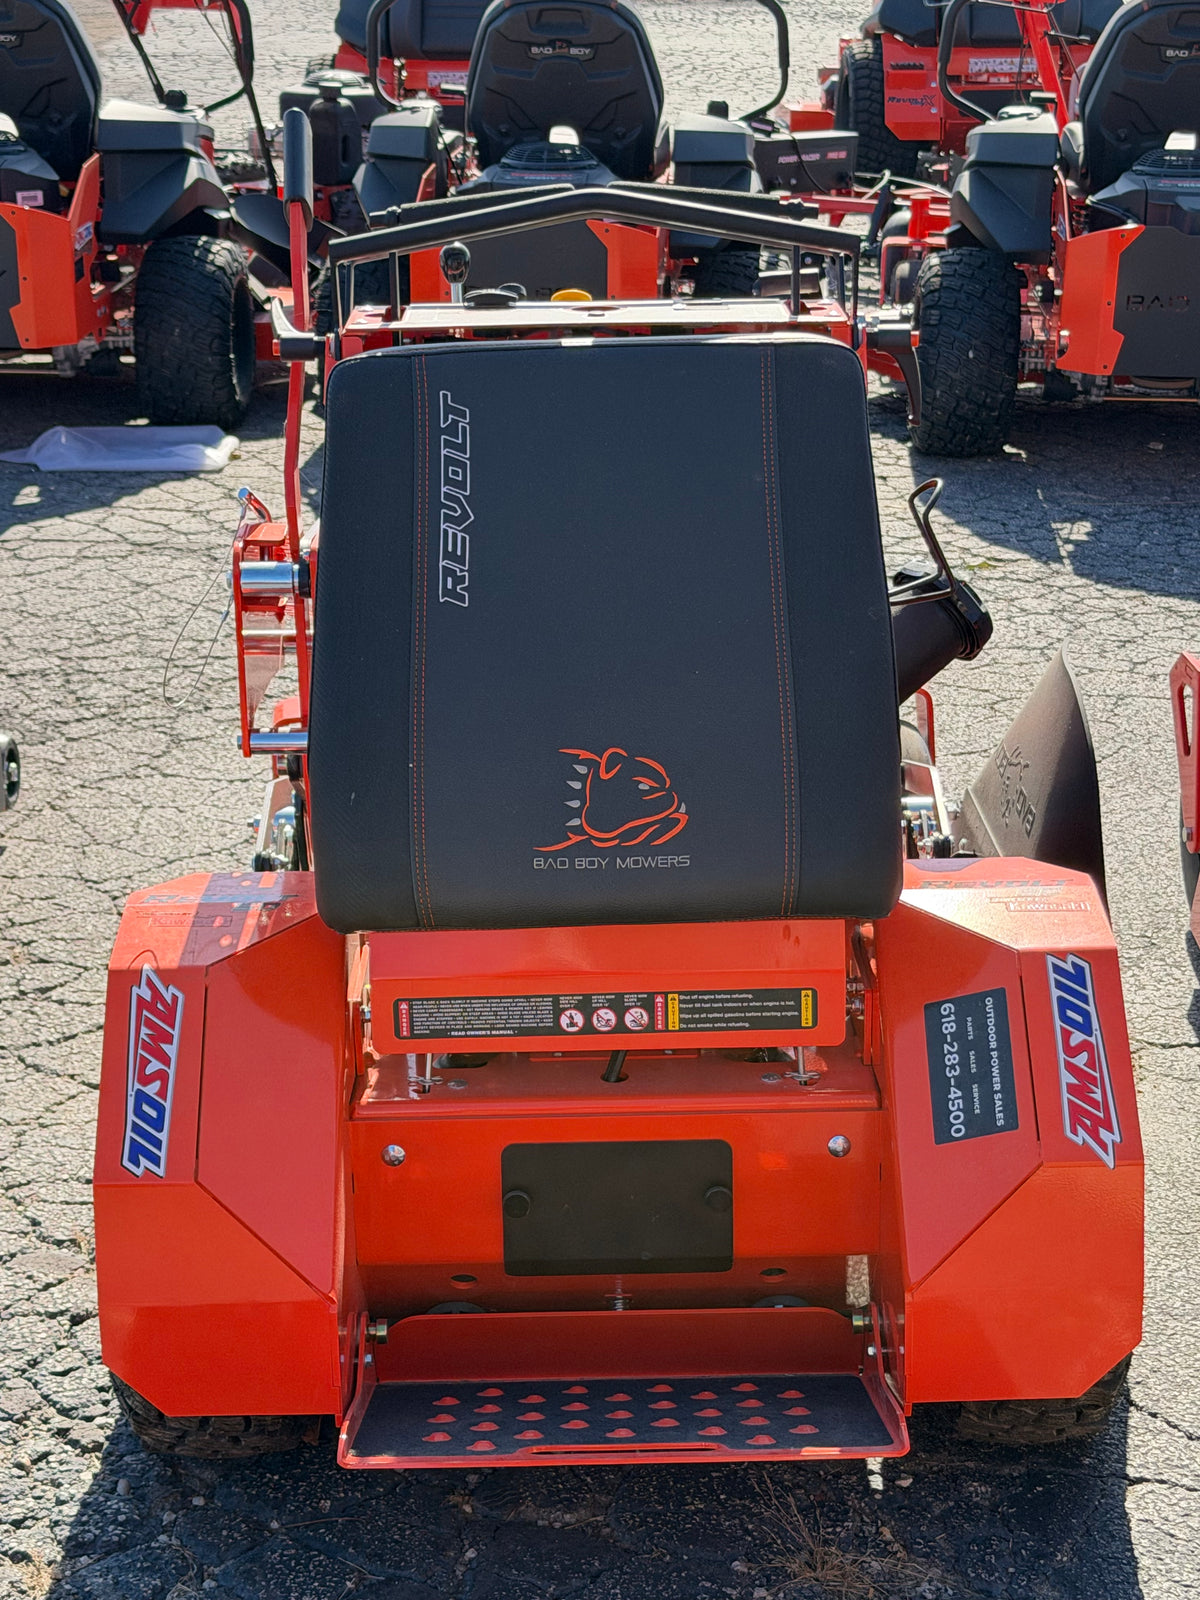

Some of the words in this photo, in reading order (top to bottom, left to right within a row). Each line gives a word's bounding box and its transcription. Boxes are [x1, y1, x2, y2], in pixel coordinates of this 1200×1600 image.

[440, 390, 474, 608] REVOLT
[534, 858, 569, 869] BAD
[575, 857, 610, 869] BOY
[616, 855, 691, 869] MOWERS
[984, 996, 997, 1049] OUTDOOR
[125, 970, 181, 1173] AMSOIL
[940, 1002, 966, 1138] 618-283-4500
[990, 1050, 1001, 1091] POWER
[1050, 957, 1118, 1161] AMSOIL
[972, 1084, 980, 1114] SERVICE
[994, 1093, 1005, 1127] SALES
